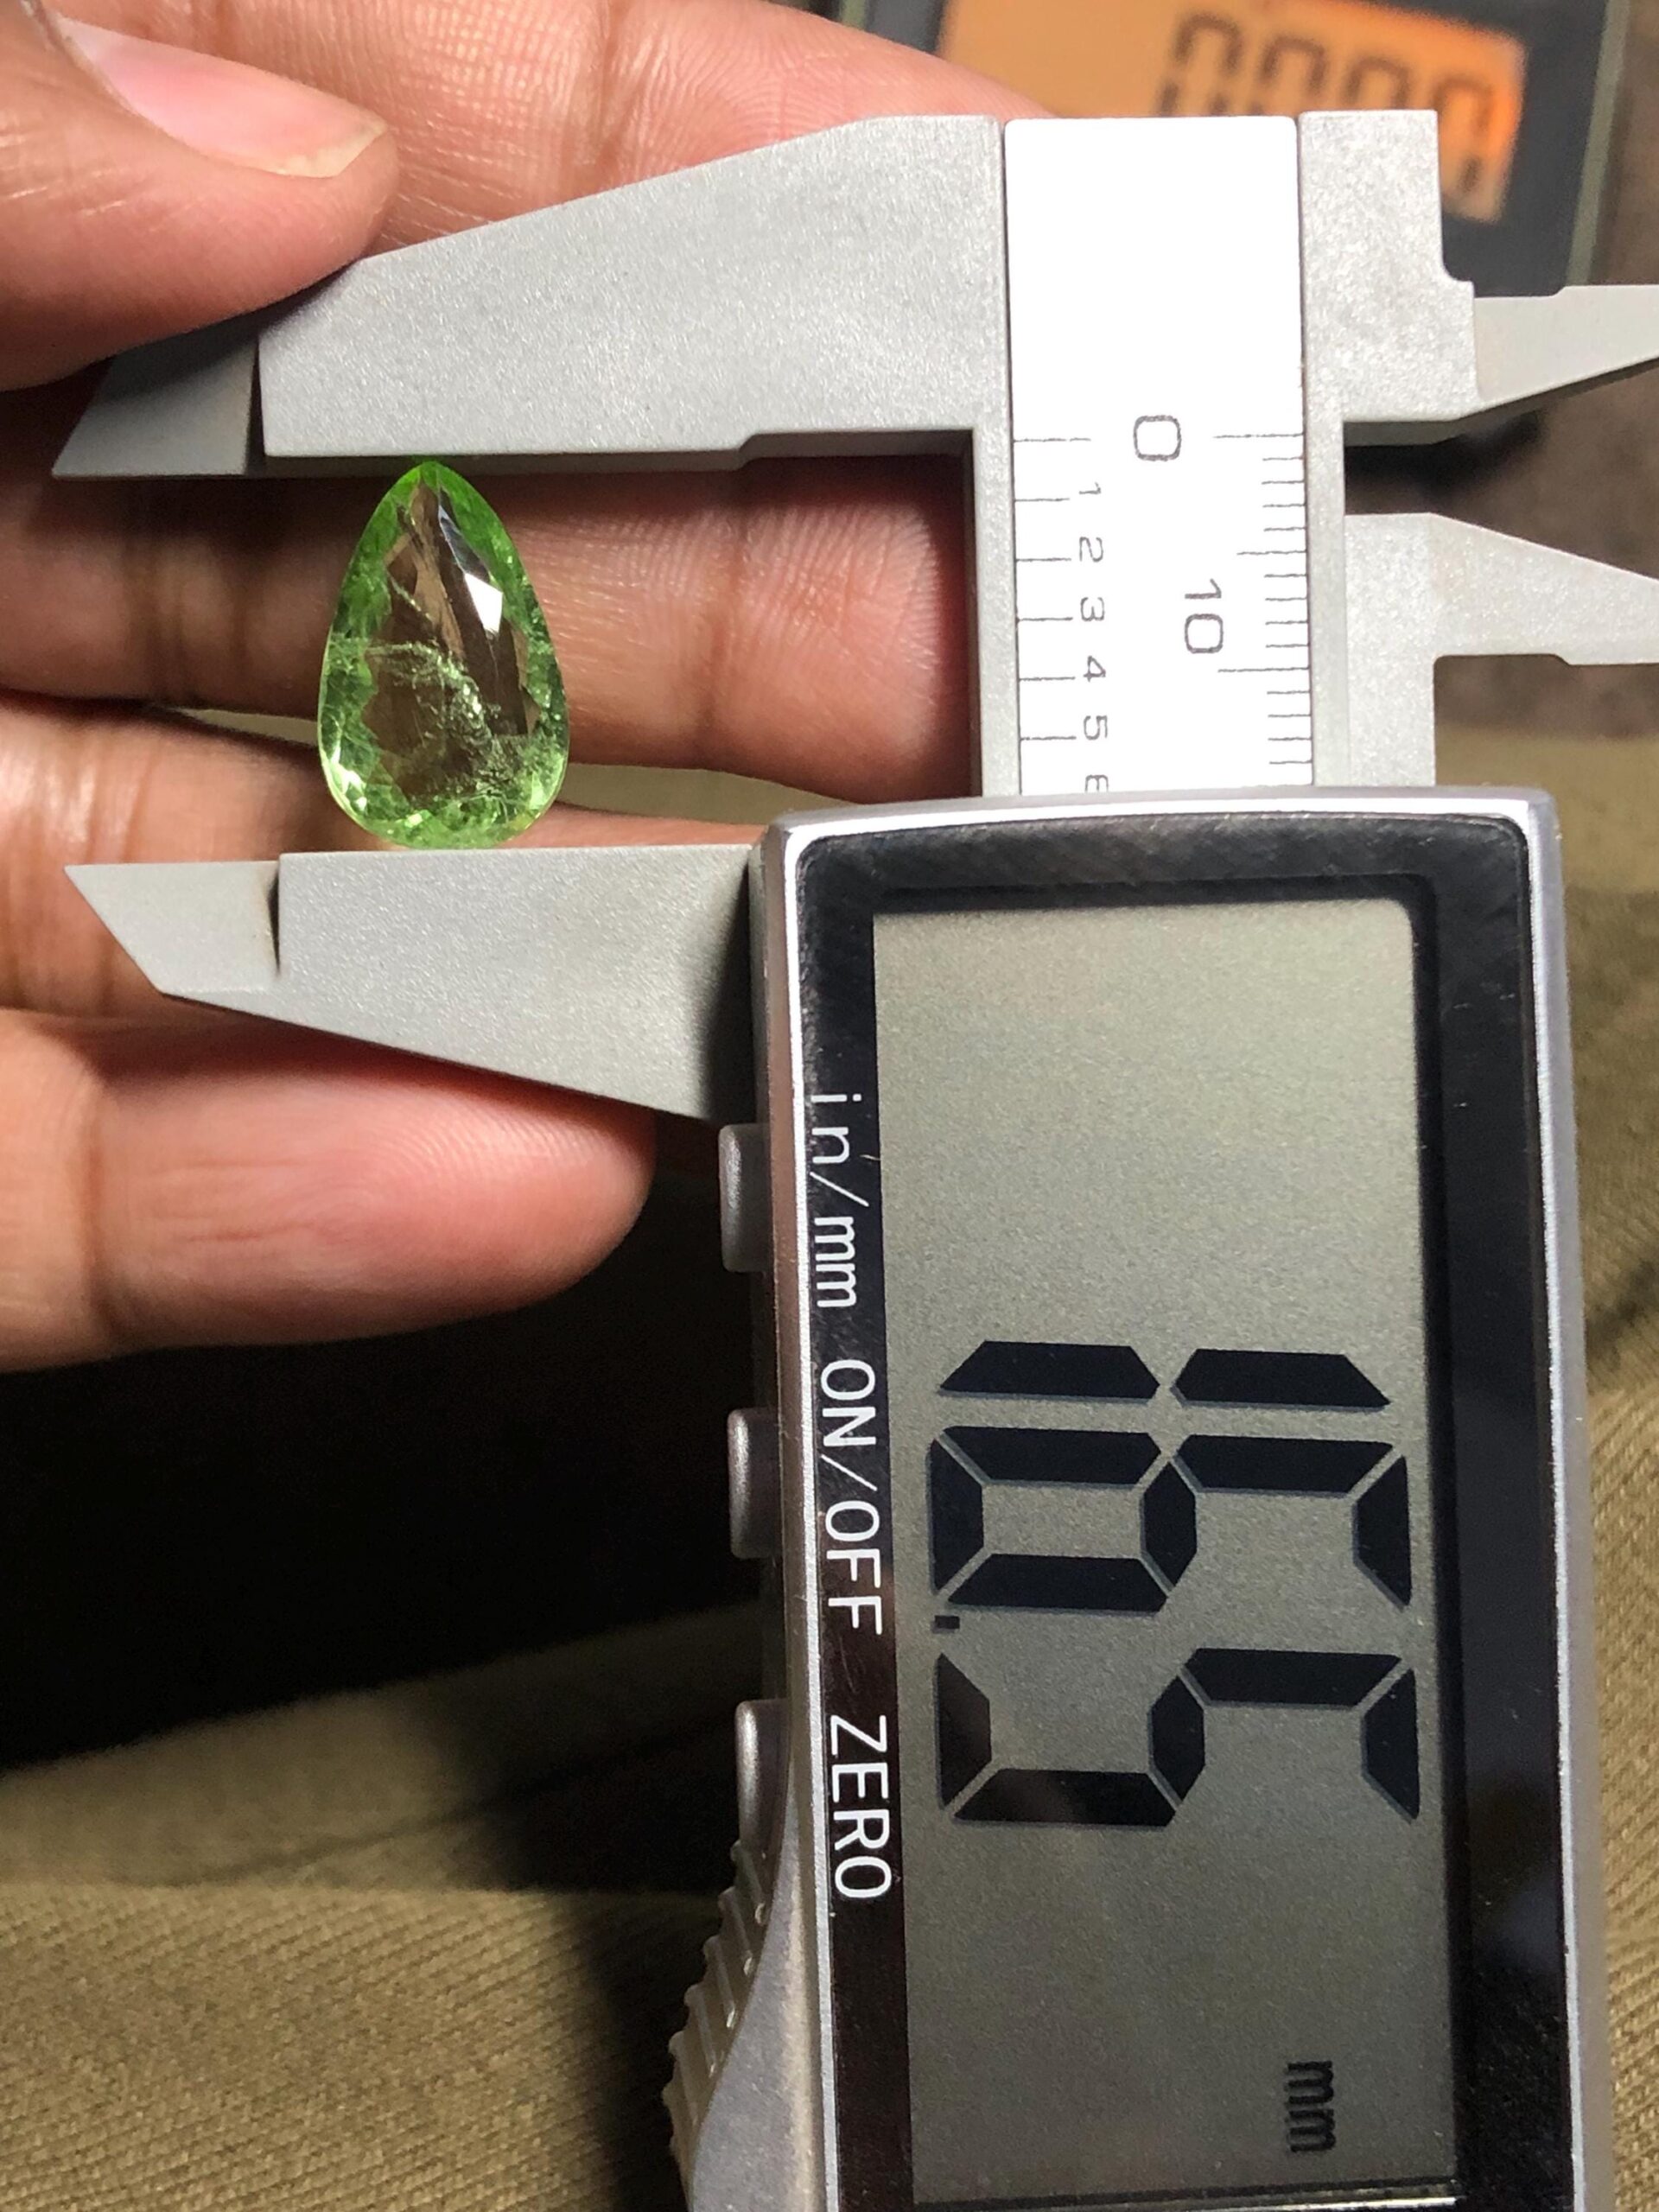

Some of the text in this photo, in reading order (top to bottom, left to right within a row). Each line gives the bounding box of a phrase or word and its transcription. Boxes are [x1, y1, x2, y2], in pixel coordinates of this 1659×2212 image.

[1133, 415, 1182, 462] 0
[1079, 482, 1102, 496] 1
[1079, 536, 1104, 563] 2
[1079, 596, 1105, 622] 3
[1184, 578, 1224, 654] 10
[1083, 655, 1107, 683] 4
[1083, 715, 1108, 741] 5
[810, 1092, 893, 1899] in/mm ON/OFF ZERO
[926, 1339, 1421, 1829] 16.5
[1286, 2060, 1337, 2153] mm
